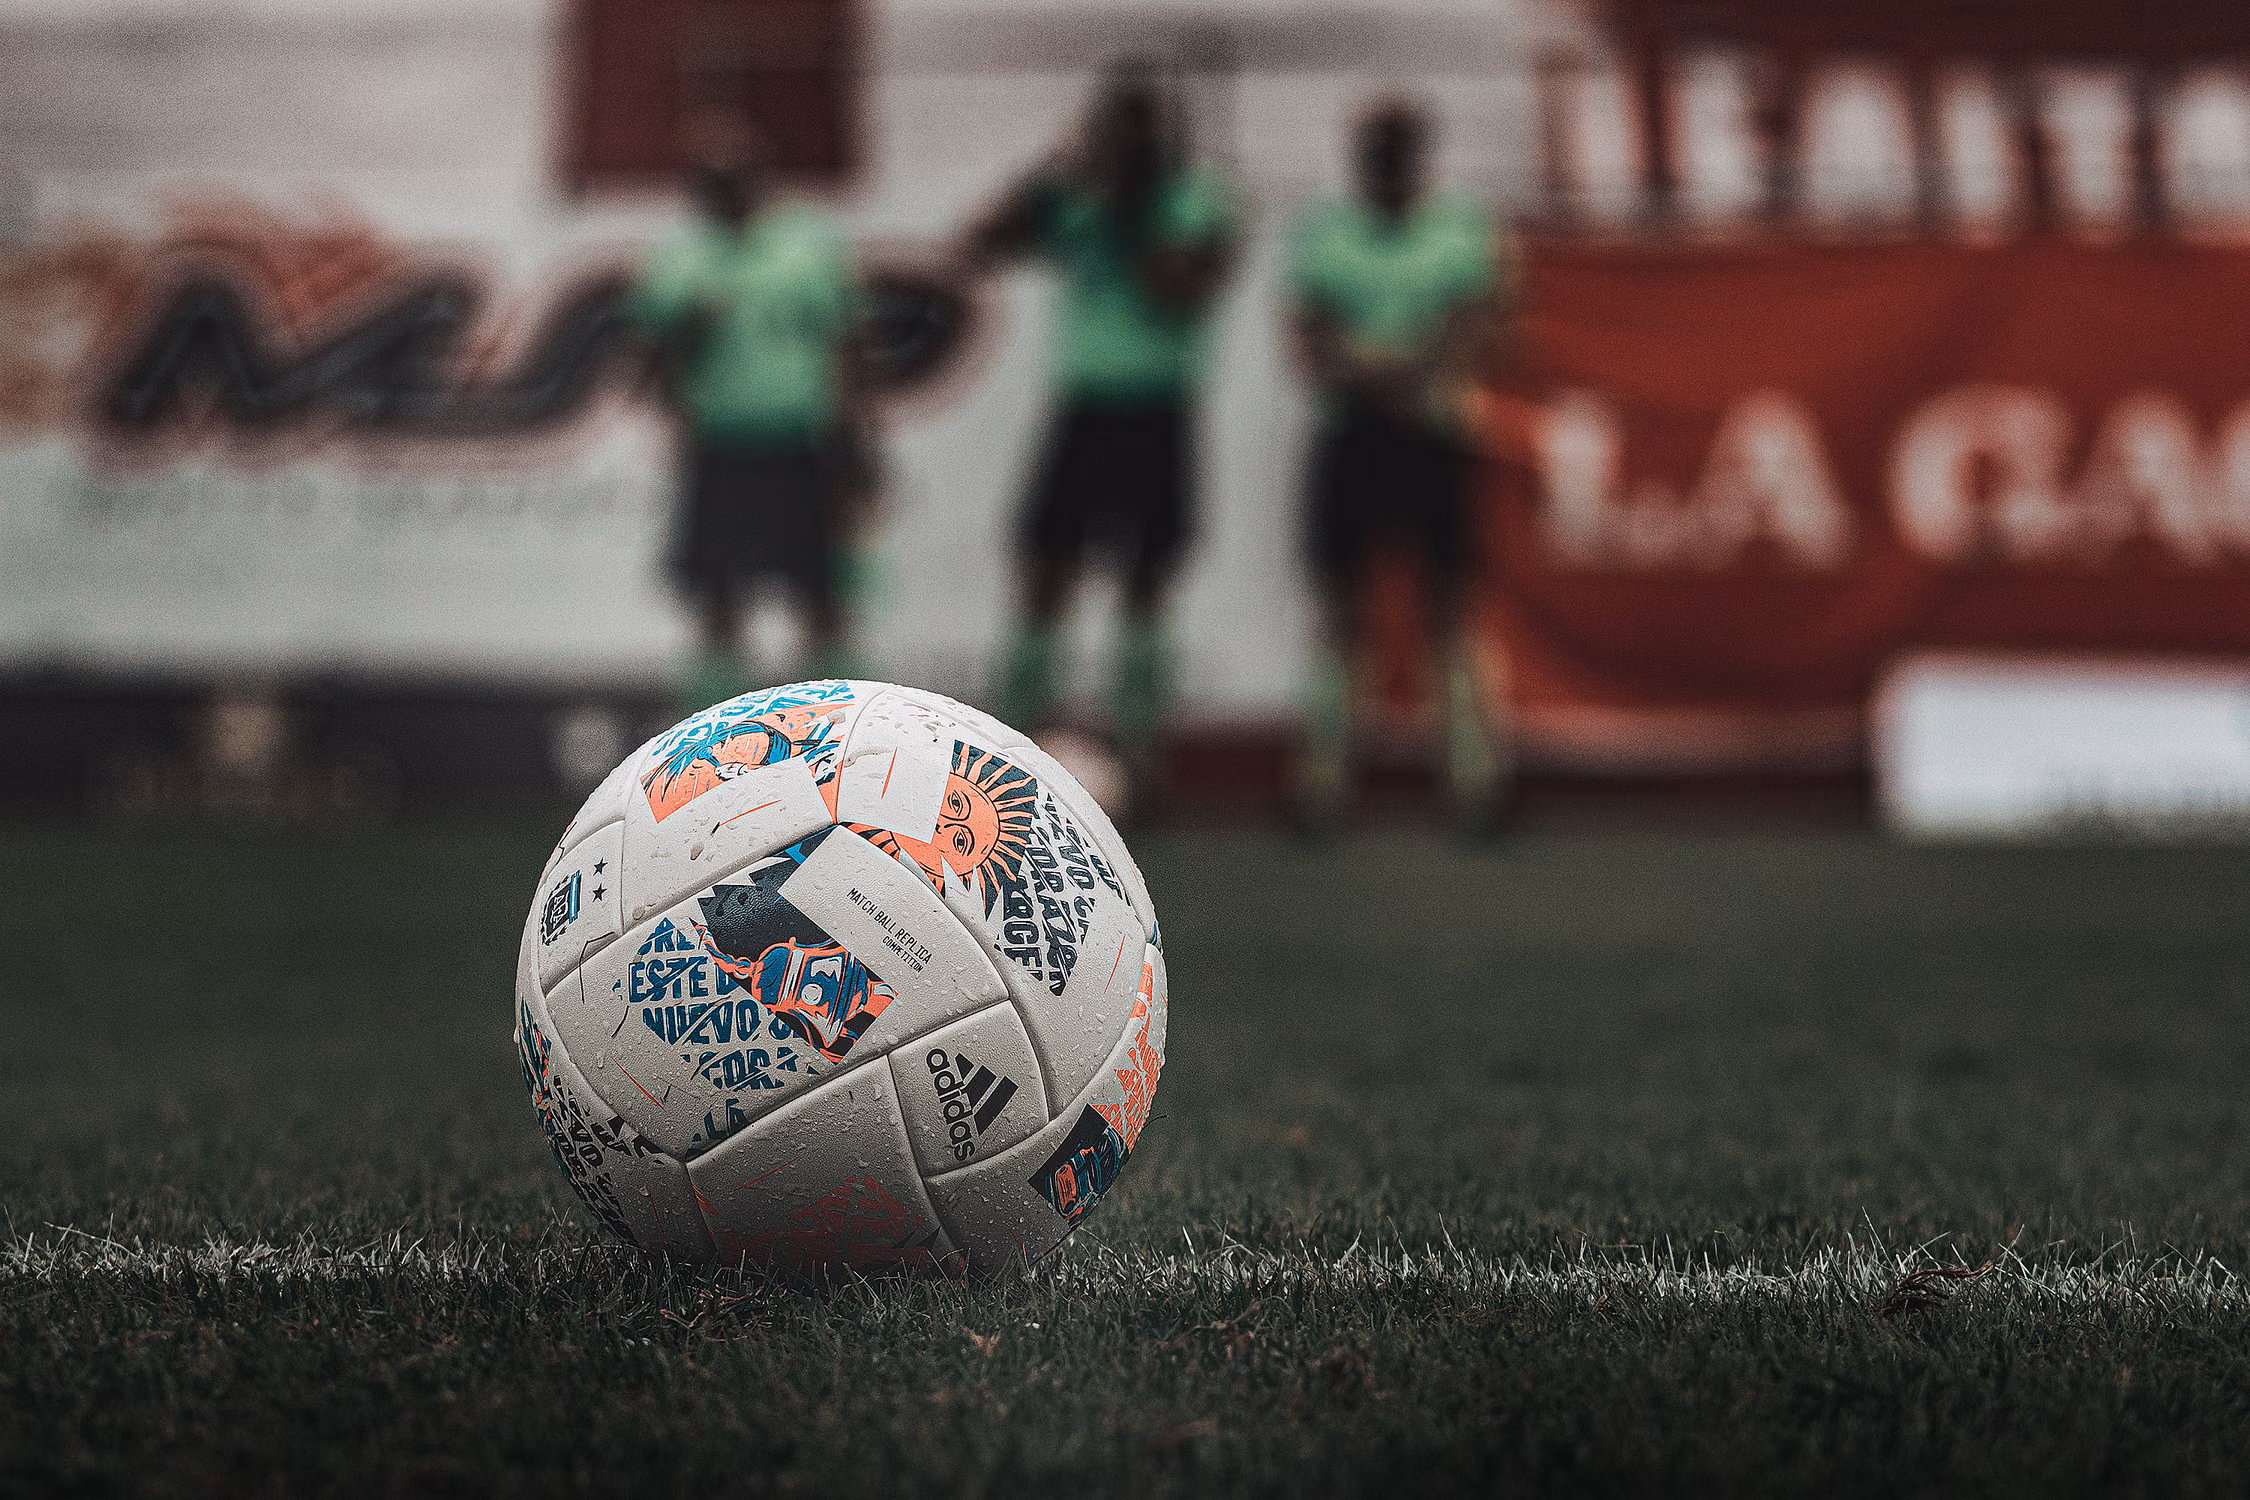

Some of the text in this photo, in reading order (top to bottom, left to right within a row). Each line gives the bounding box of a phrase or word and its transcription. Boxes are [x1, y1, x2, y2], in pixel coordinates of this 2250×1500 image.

[846, 887, 933, 965] MATCH BALL REPLICA
[882, 935, 924, 973] COMPETITION
[628, 956, 709, 1003] ESTE
[642, 998, 762, 1046] NUEVO
[925, 1048, 975, 1161] adidas
